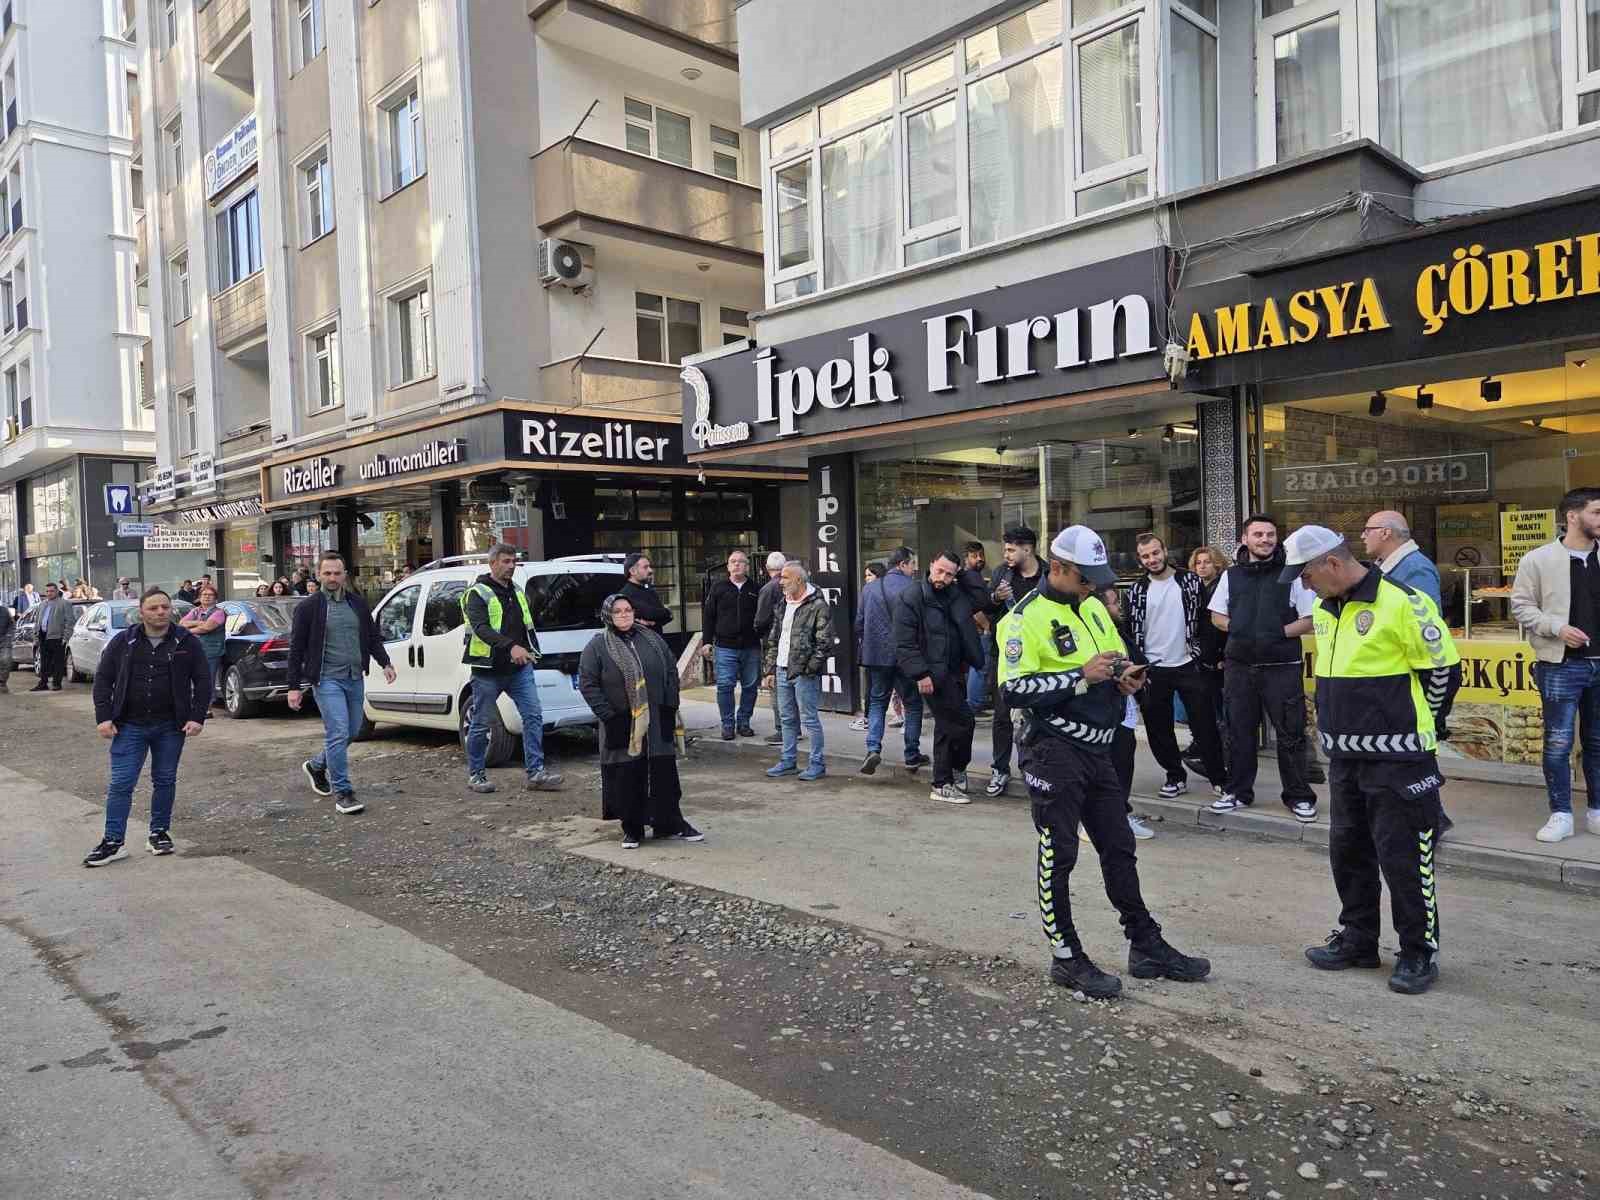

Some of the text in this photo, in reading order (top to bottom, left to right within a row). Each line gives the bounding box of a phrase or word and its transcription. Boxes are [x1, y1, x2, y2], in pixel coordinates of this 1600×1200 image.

[1187, 278, 1392, 361] AMASYA
[752, 293, 1158, 437] İpek Fırın
[283, 438, 459, 494] Rizeliler unlu mamülleri
[521, 418, 669, 461] Rizeliler
[1459, 652, 1539, 697] EKÇİS
